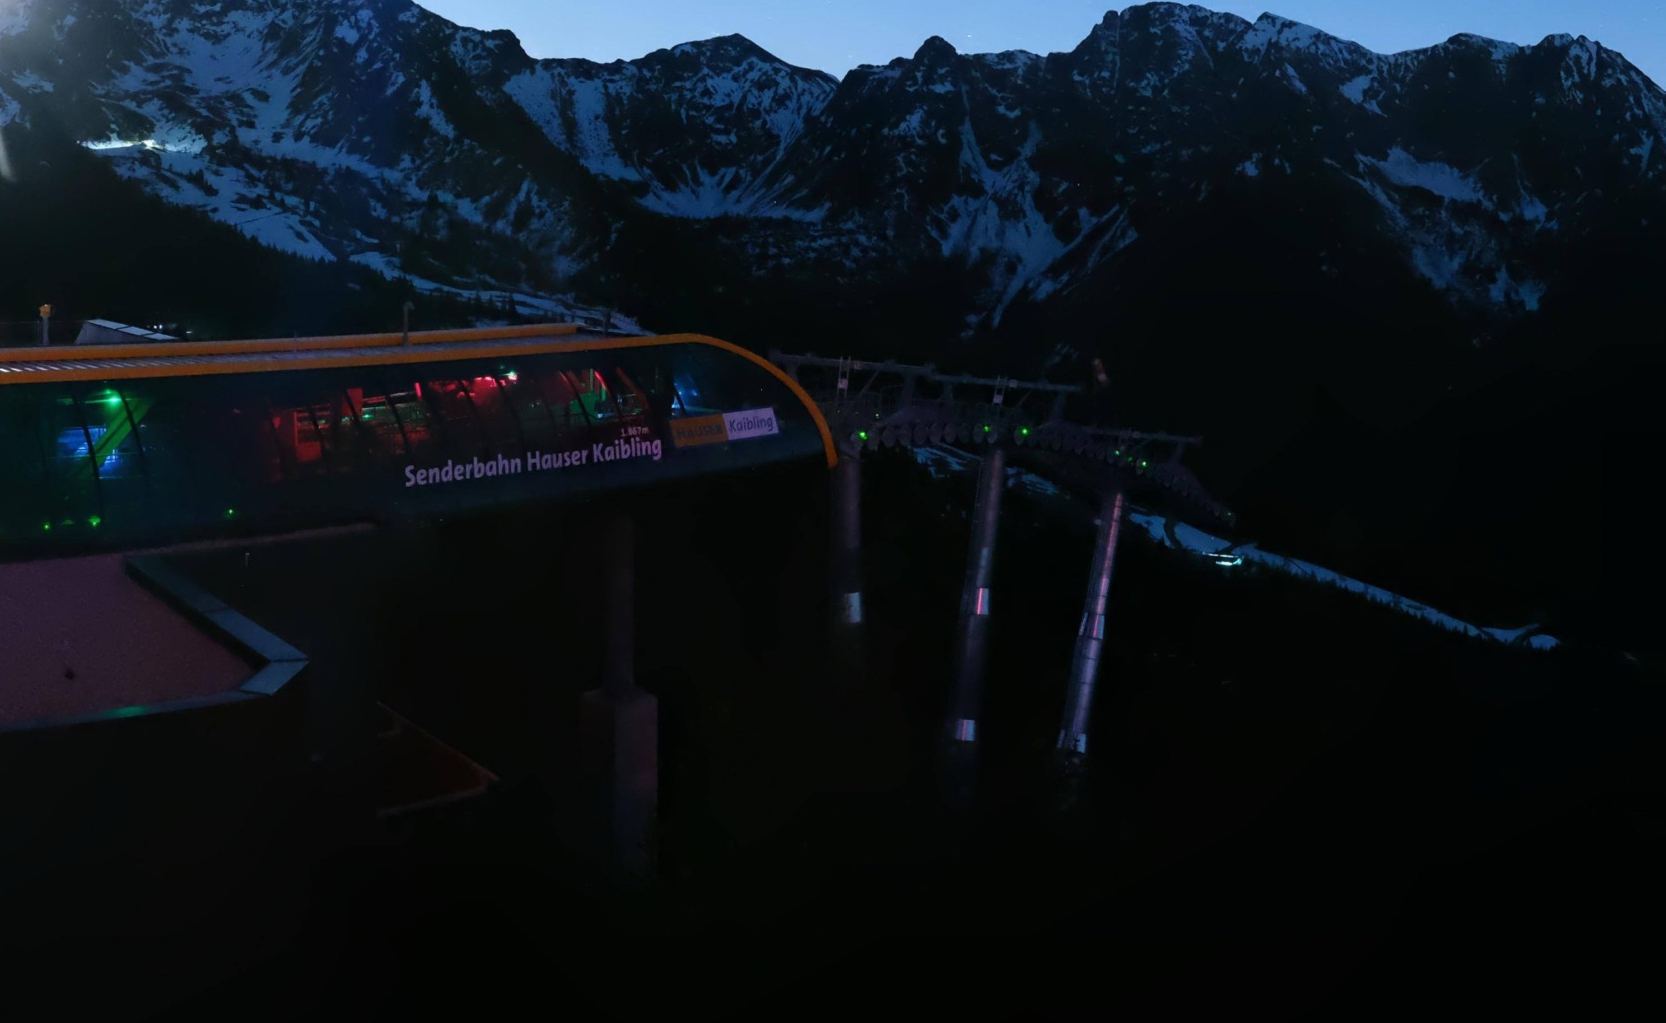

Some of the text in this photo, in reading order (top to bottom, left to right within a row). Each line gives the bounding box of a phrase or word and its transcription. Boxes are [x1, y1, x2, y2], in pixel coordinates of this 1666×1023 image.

[729, 416, 774, 433] Kaibling
[404, 438, 663, 487] Senderbahn Hauser Kaibling
